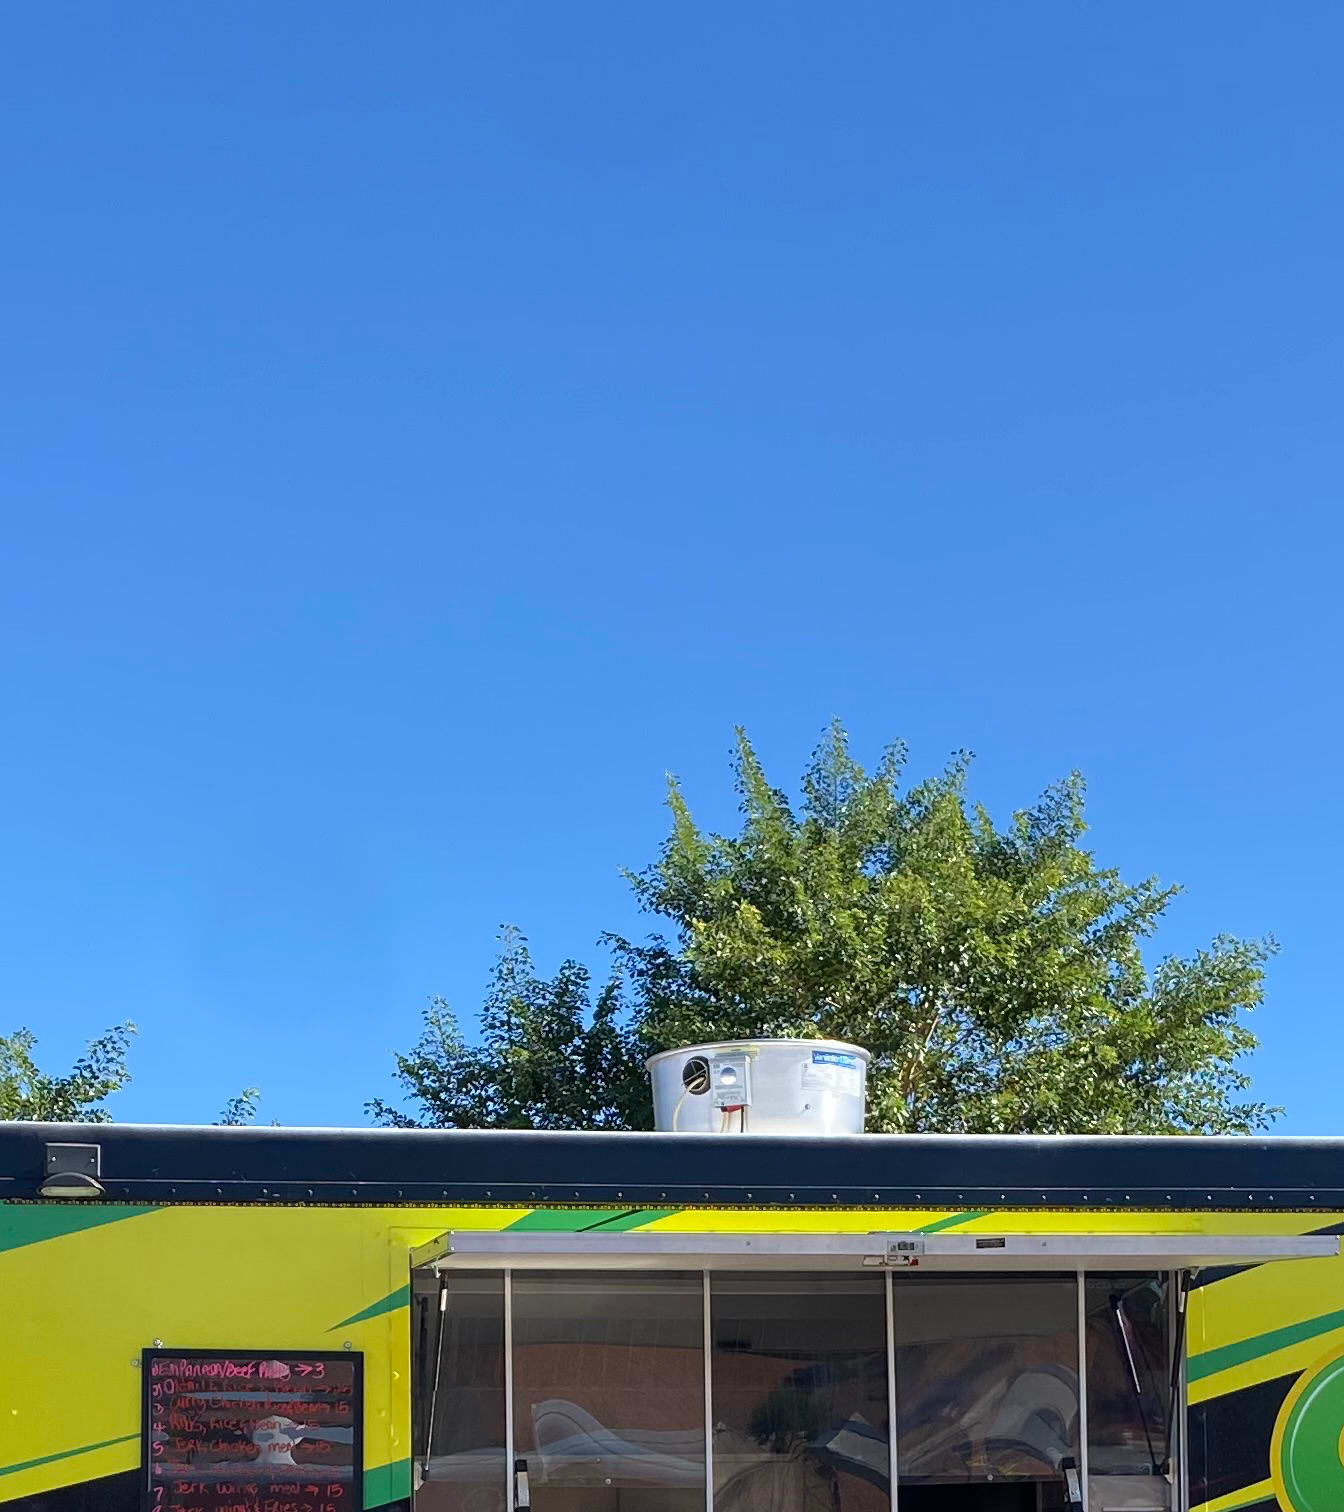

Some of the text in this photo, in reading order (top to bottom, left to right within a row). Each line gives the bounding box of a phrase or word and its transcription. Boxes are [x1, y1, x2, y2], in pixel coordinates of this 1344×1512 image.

[312, 1362, 326, 1379] 3
[153, 1440, 164, 1457] 5
[153, 1486, 165, 1502] 7
[327, 1483, 344, 1497] 15
